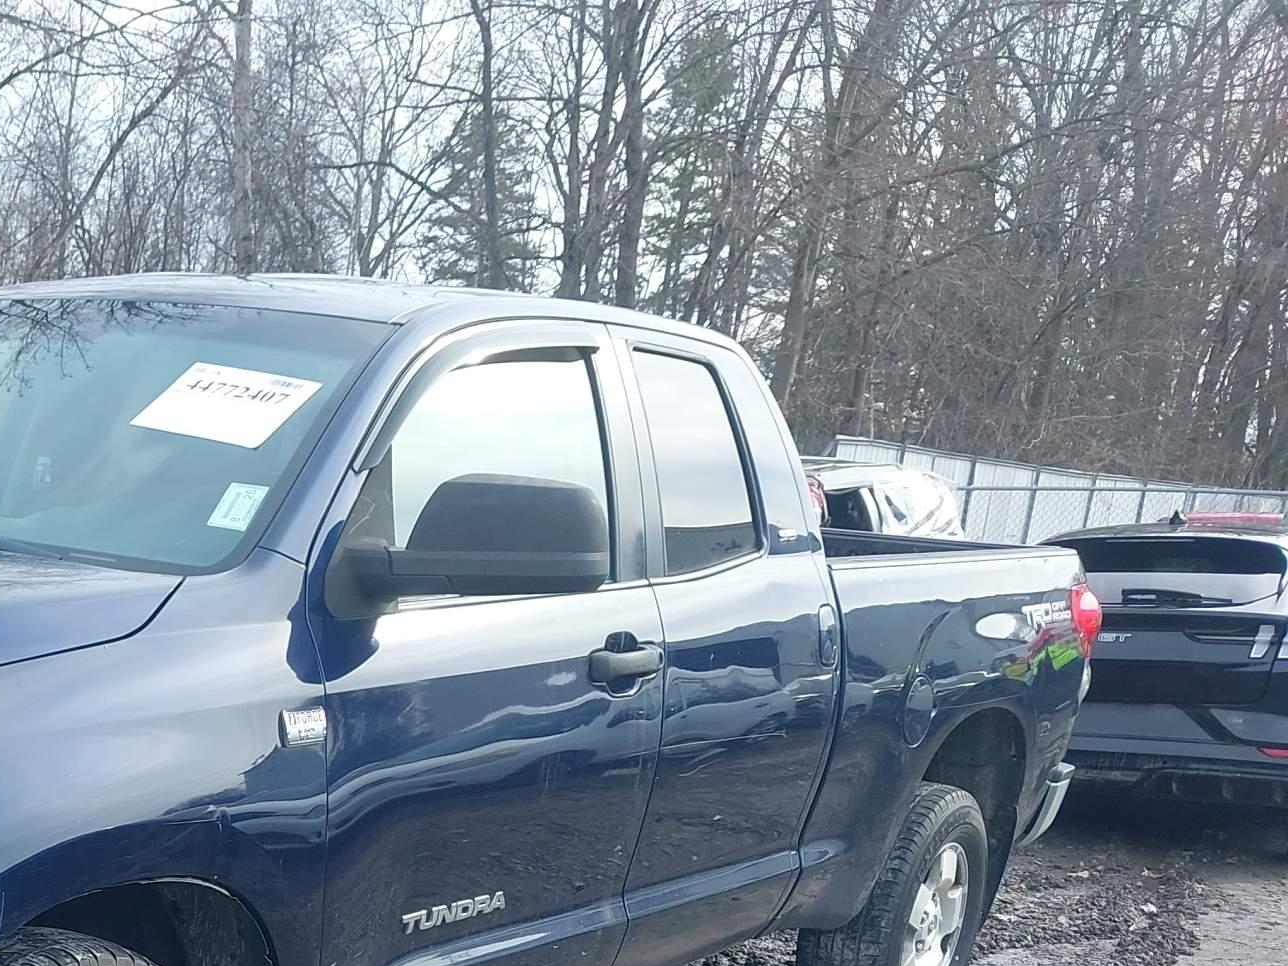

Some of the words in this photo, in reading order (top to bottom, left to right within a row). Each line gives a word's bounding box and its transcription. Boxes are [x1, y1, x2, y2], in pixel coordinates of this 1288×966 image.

[187, 380, 291, 405] 44772407
[1022, 602, 1052, 630] TRD
[402, 891, 506, 935] TUNDRA
